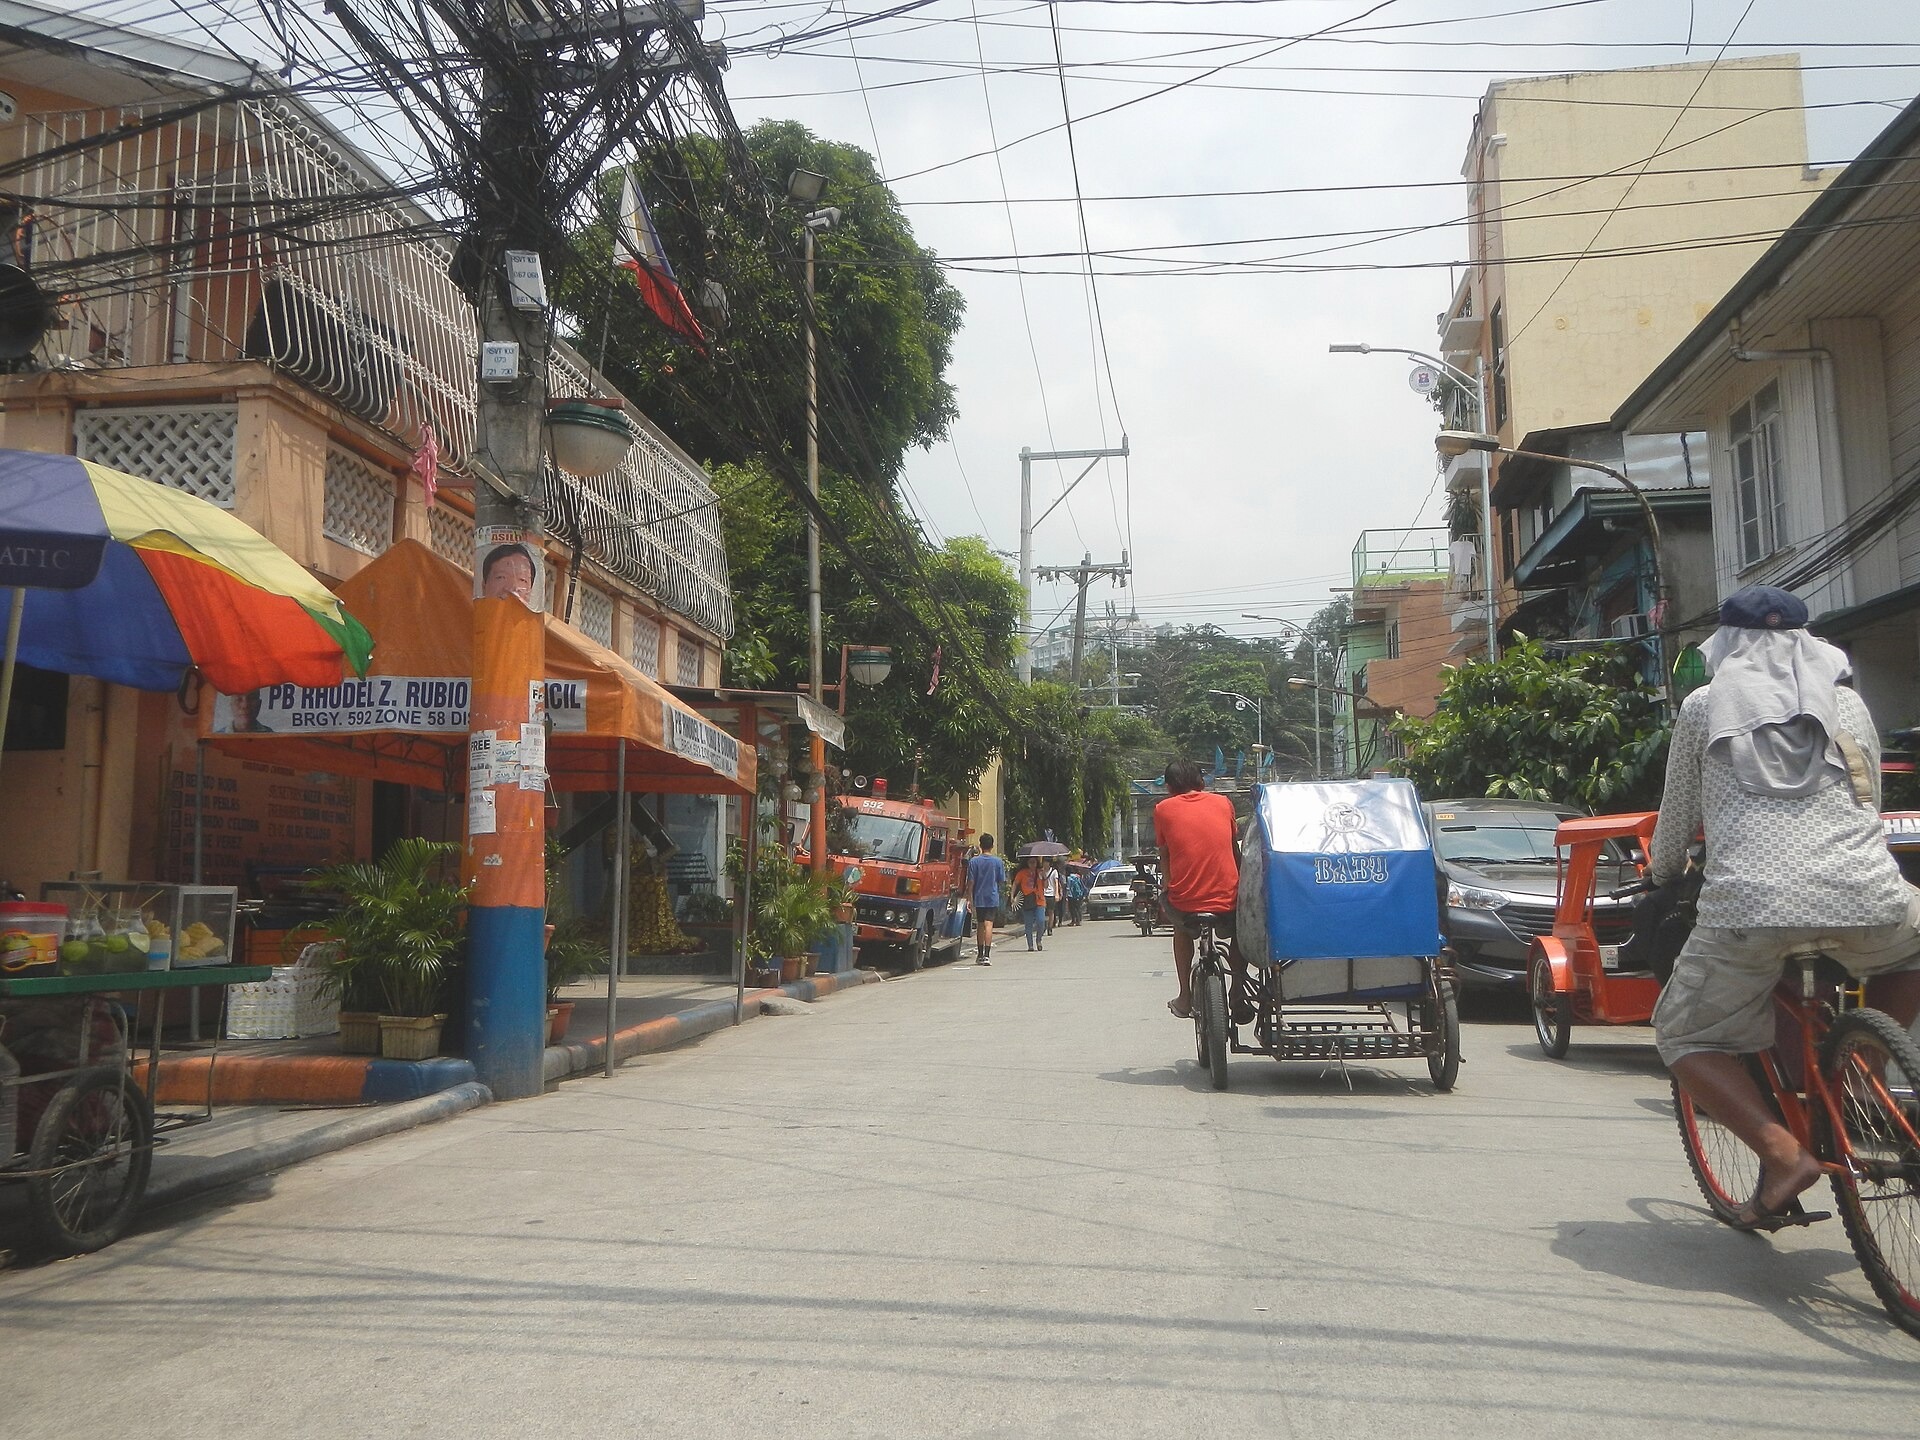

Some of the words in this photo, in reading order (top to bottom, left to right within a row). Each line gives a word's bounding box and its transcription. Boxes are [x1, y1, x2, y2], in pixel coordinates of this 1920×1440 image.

[268, 683, 296, 710] PB
[378, 680, 397, 707] Z.
[405, 681, 468, 709] RUBIO
[292, 711, 343, 727] BRGY.
[347, 711, 372, 726] 592
[375, 709, 422, 726] ZONE
[427, 711, 446, 726] 58
[471, 739, 491, 751] FREE
[862, 799, 885, 810] 592
[1314, 855, 1389, 884] BABY
